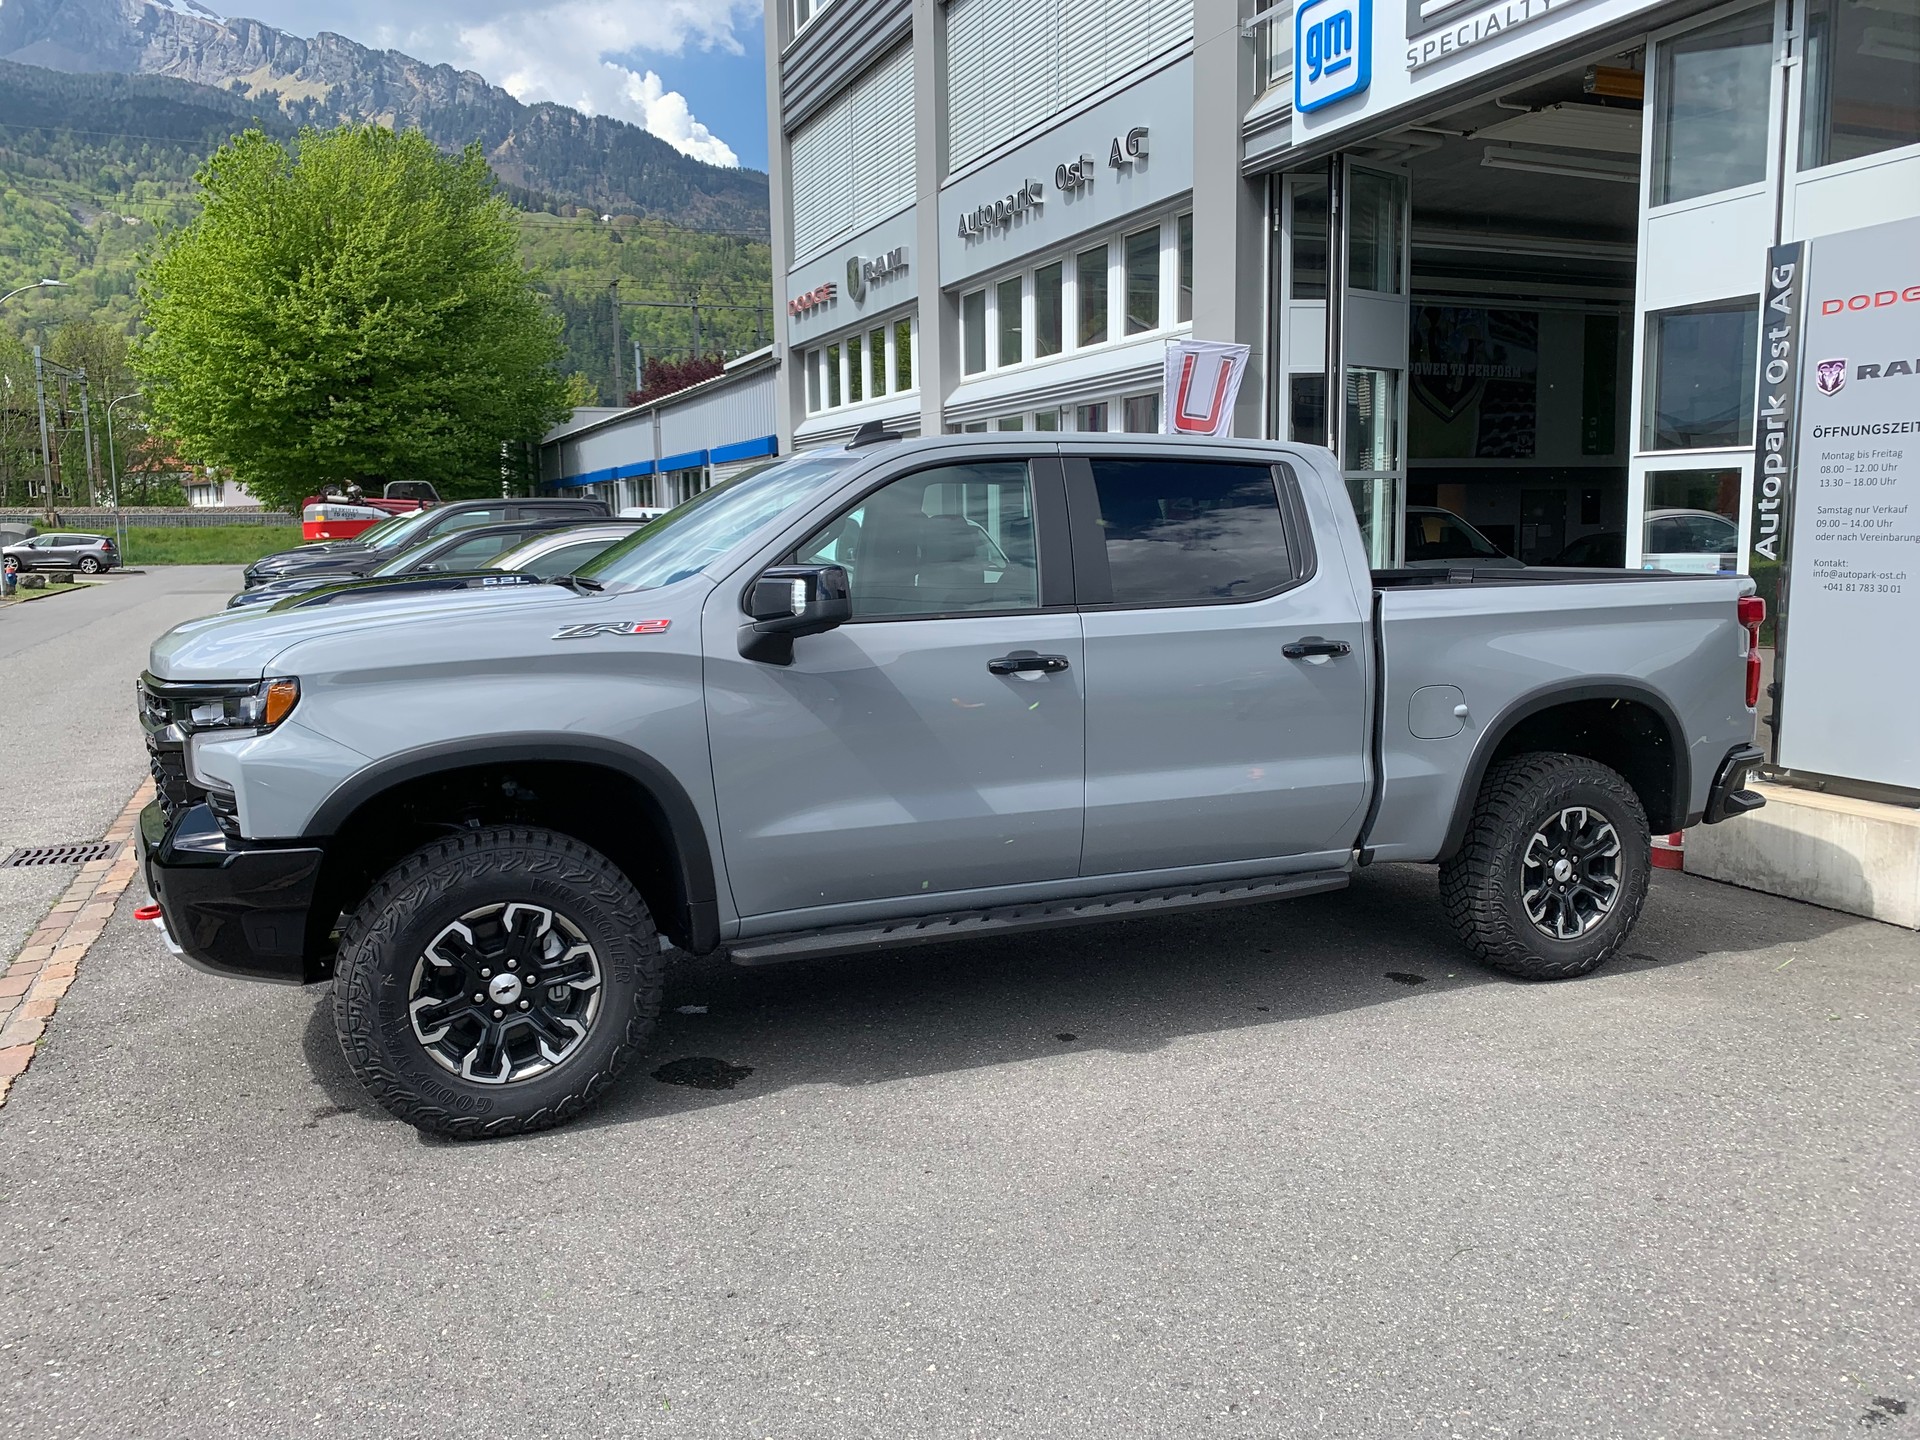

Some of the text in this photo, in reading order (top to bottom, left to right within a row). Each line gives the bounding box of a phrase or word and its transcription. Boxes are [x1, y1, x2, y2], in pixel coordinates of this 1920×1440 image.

[1306, 9, 1352, 82] gm
[958, 127, 1144, 237] Autopark Ost AG
[789, 247, 904, 316] DODGE RAM
[1409, 362, 1521, 378] POWER TO PERFORM
[1857, 358, 1920, 380] RA
[1174, 352, 1235, 435] U
[1755, 263, 1795, 561] Autopark Ost AG
[1821, 449, 1903, 461] Montag bis Freitag
[1820, 465, 1845, 474] 08.00
[1854, 463, 1879, 473] 12.00
[1881, 463, 1898, 472] Uhr
[1820, 479, 1844, 487] 13.30
[1853, 477, 1878, 487] 18.00
[1880, 477, 1897, 486] Uhr
[1817, 505, 1853, 515] Samstag
[1873, 504, 1908, 514] Verkauf
[1816, 519, 1841, 528] 09.00
[1850, 519, 1875, 528] 14.00
[1877, 519, 1893, 528] Uhr
[1815, 532, 1920, 544] oder nach Vereinbarung
[1813, 559, 1849, 567] Kontakt:
[1813, 569, 1907, 580] info@autopark-ost.ch
[1823, 582, 1901, 593] +041 81 783 30 01
[550, 619, 672, 640] ZR2
[378, 999, 497, 1115] GOODYEAR
